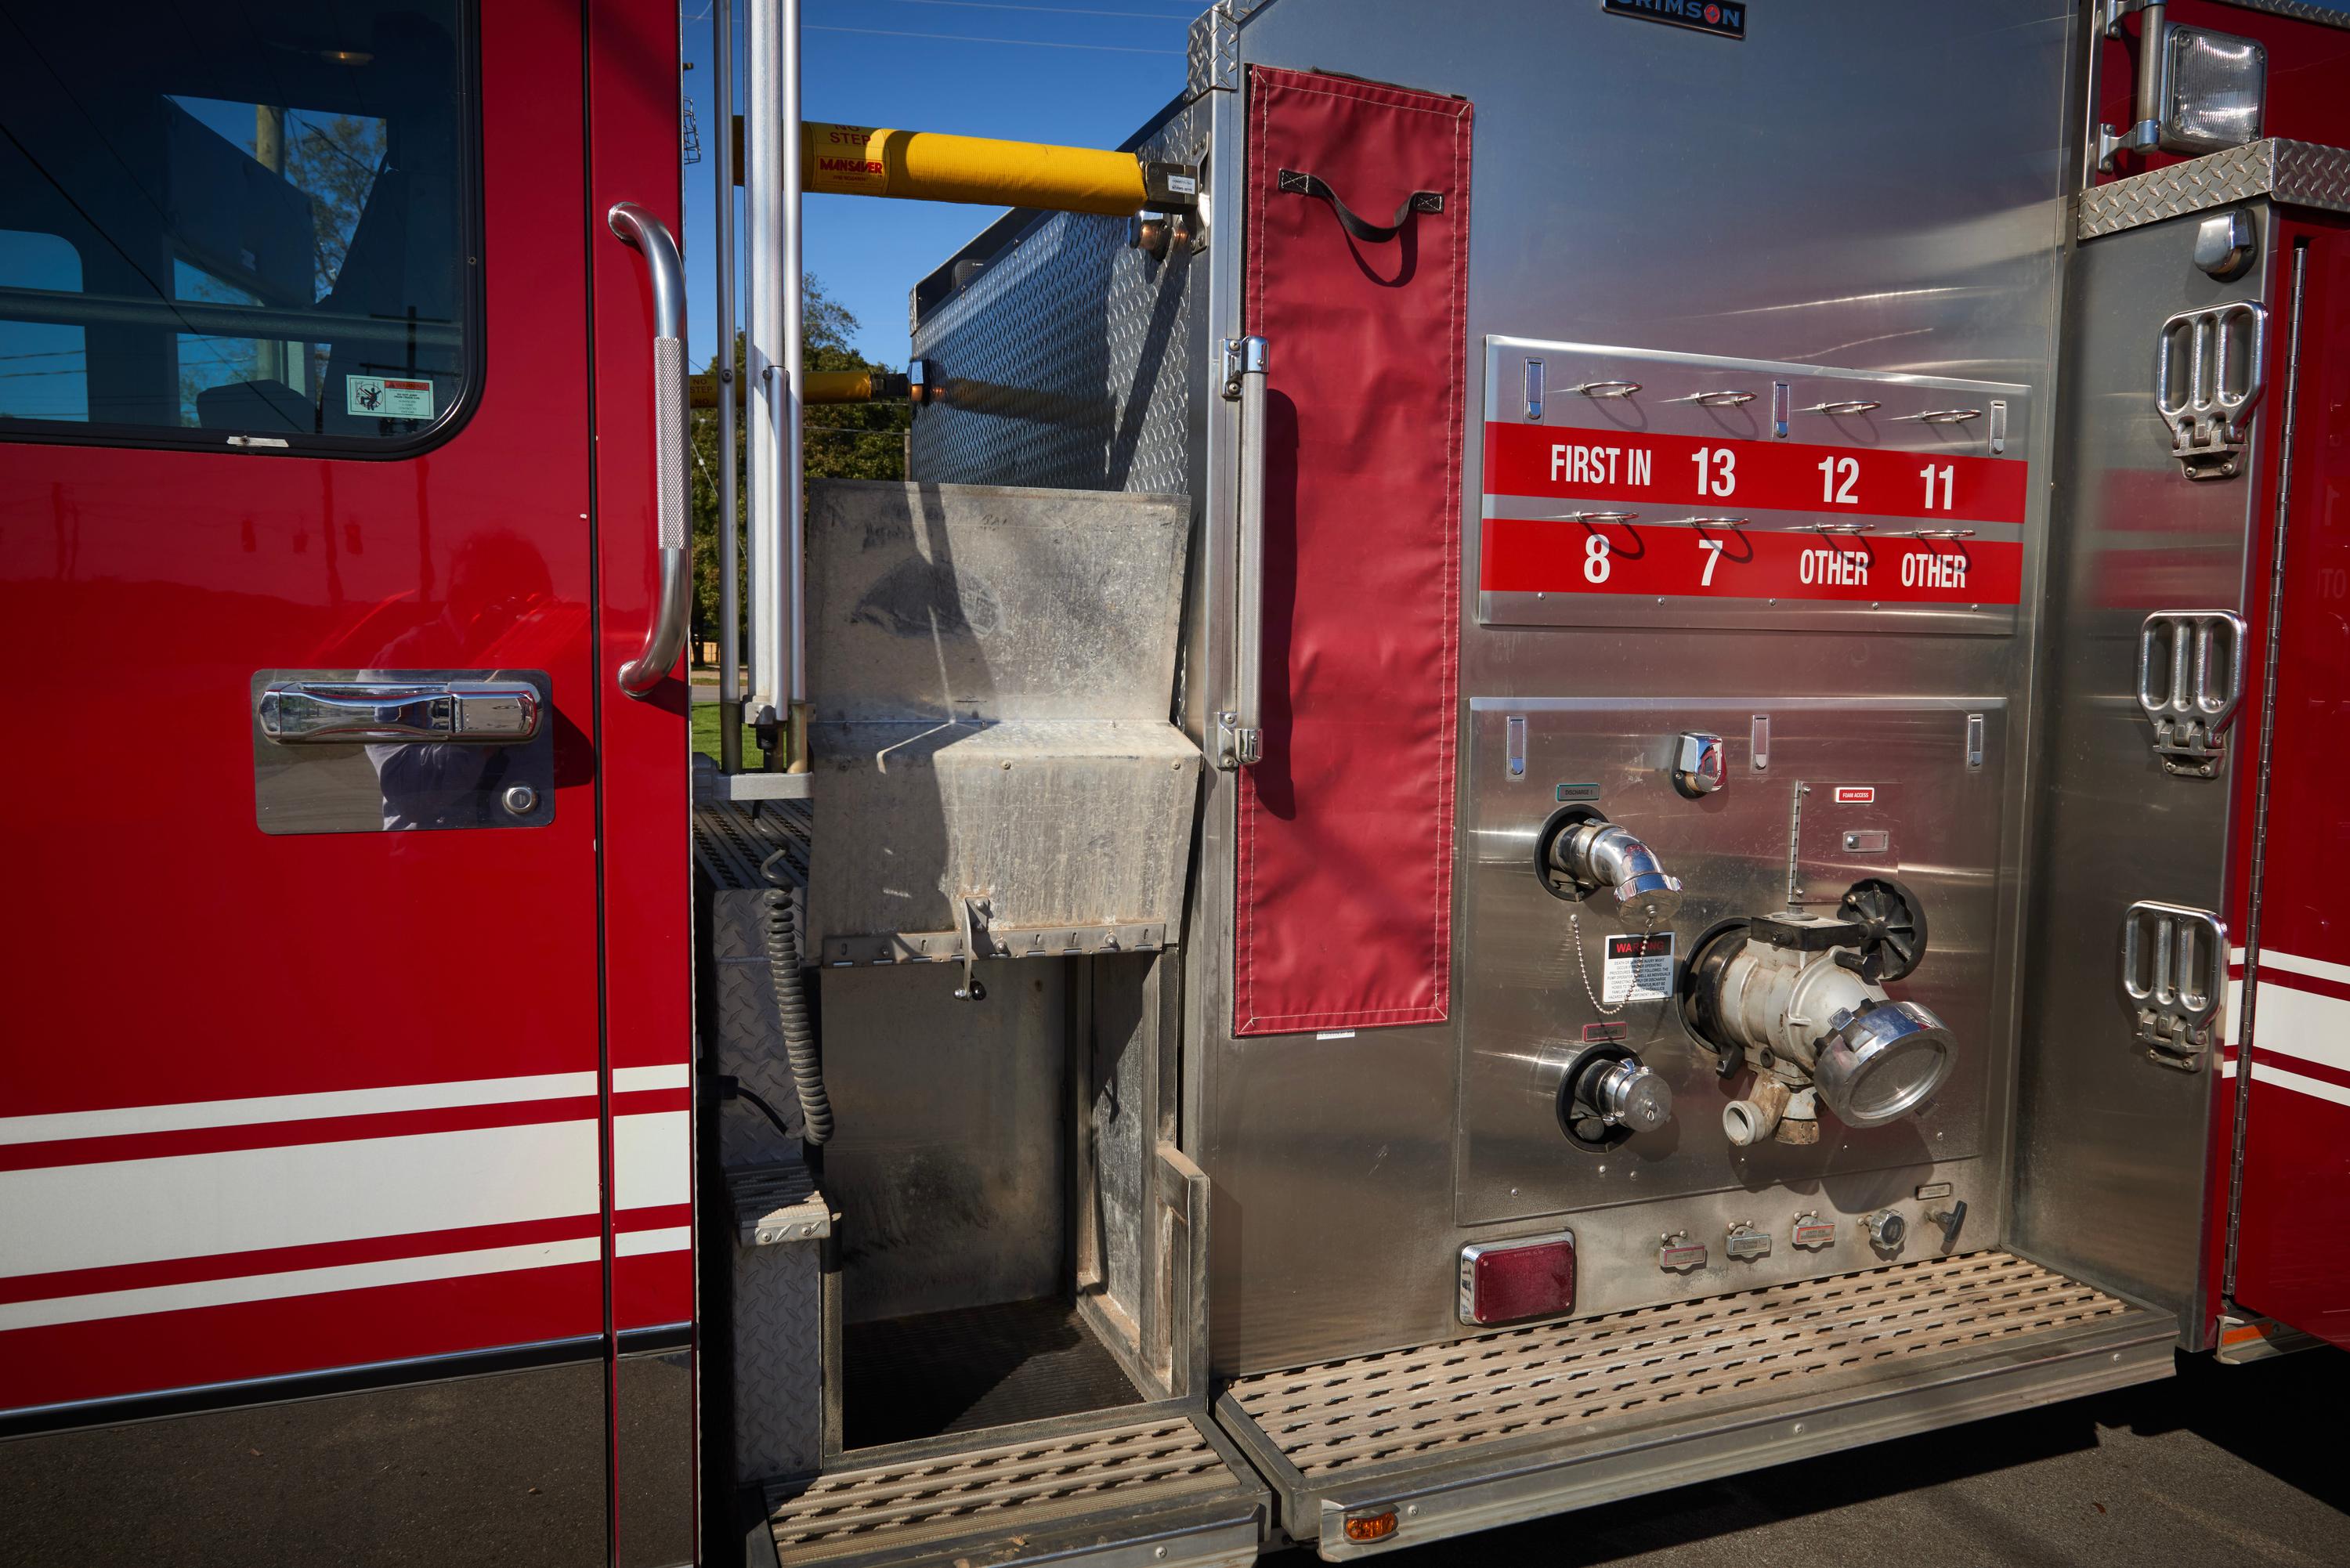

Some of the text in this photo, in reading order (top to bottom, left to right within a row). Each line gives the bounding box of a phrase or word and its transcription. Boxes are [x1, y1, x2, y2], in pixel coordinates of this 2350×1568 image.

[1616, 0, 1741, 27] RIMSON
[830, 132, 871, 146] STEP
[819, 157, 883, 175] MANSAVER
[1552, 444, 1651, 486] FIRST IN
[1691, 447, 1736, 497] 13
[1818, 457, 1859, 504] 12
[1920, 464, 1954, 509] 11
[1584, 534, 1610, 583] 8
[1698, 540, 1724, 587] 7
[1800, 549, 1868, 585] OTHER
[1902, 553, 1967, 588] OTHER
